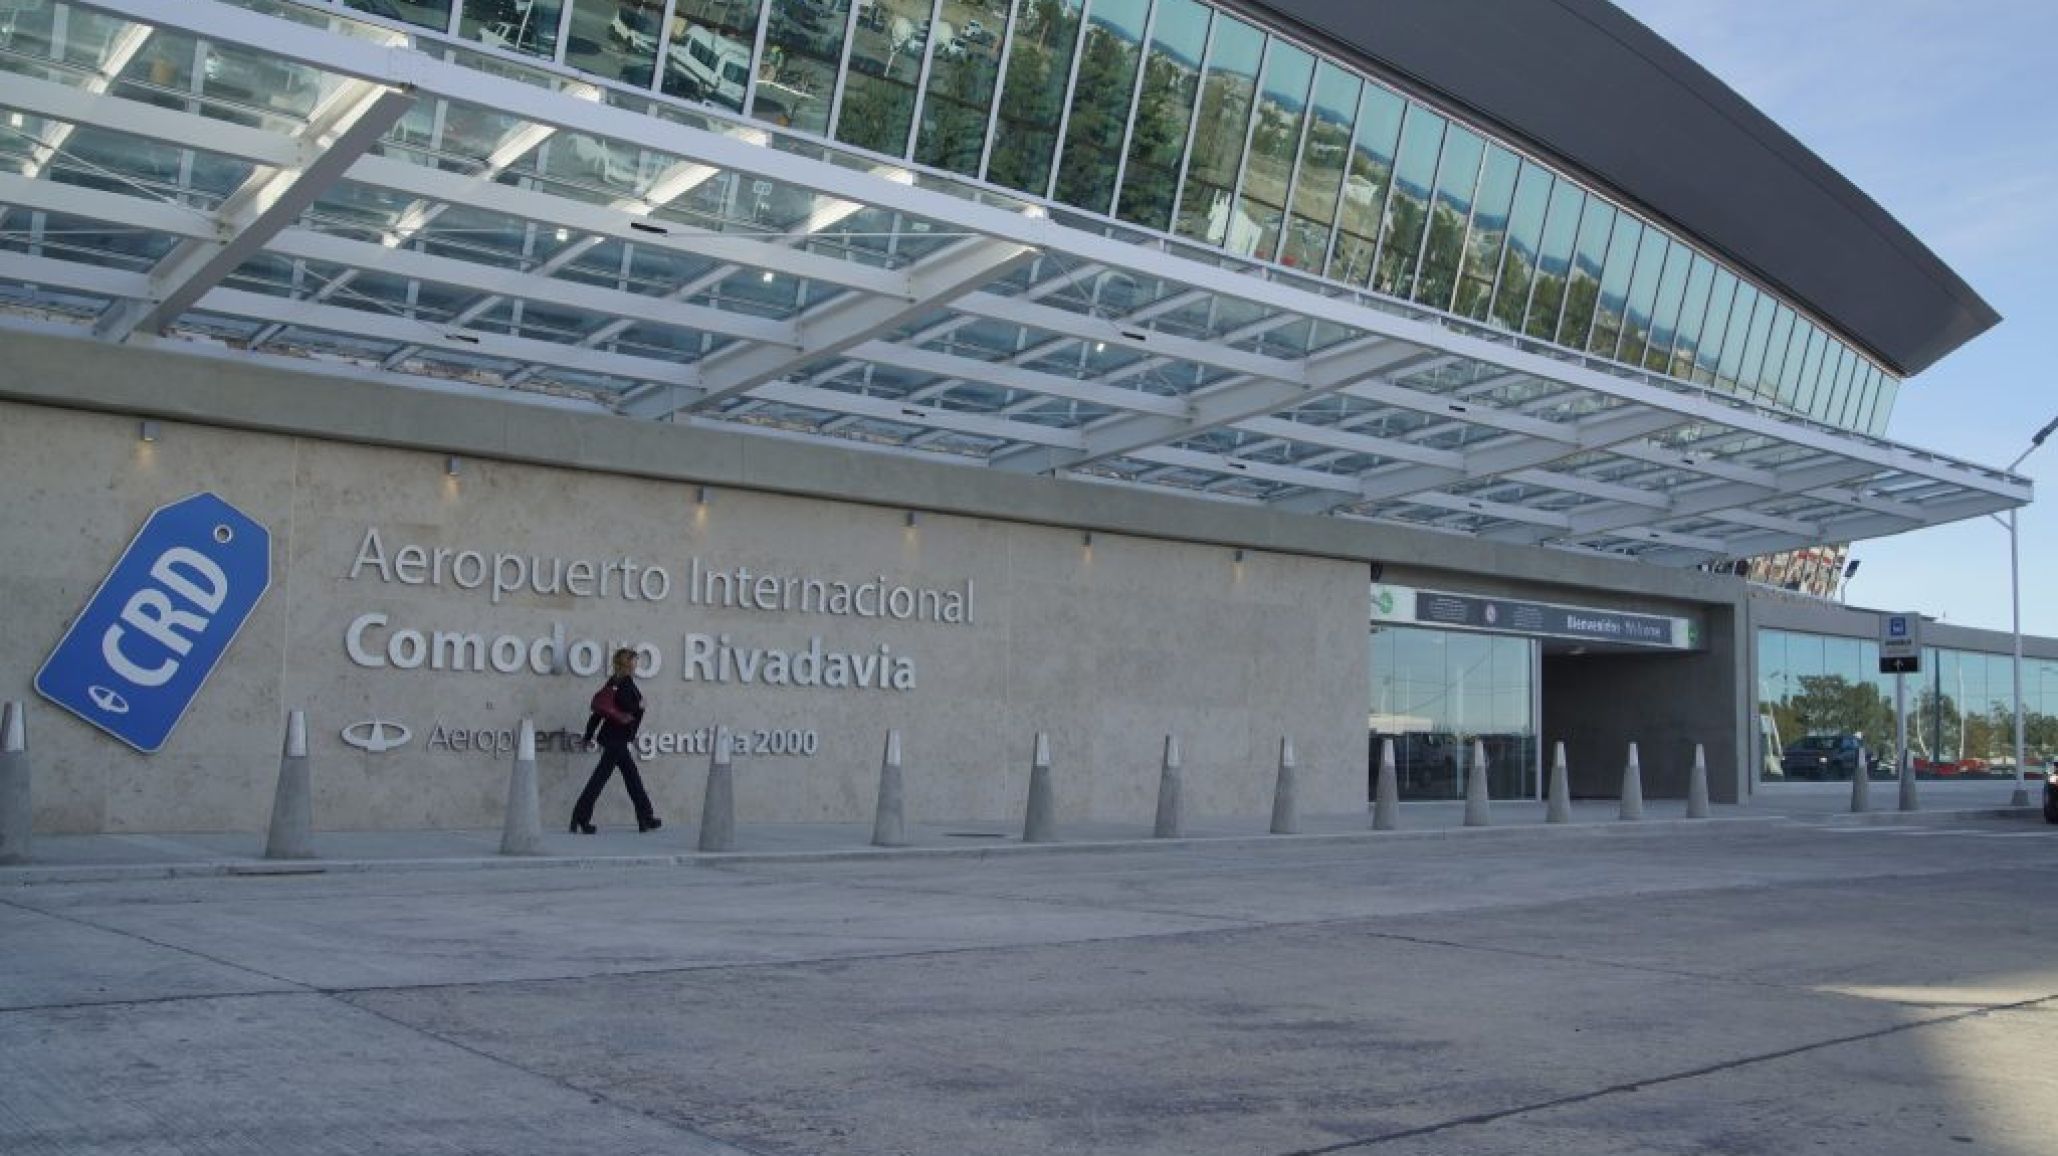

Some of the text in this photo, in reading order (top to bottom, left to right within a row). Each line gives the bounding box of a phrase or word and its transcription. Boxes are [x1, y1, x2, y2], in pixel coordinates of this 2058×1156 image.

[102, 546, 228, 687] CRD
[348, 527, 975, 624] Aeropuerto Internacional
[683, 632, 916, 690] Rivadavia
